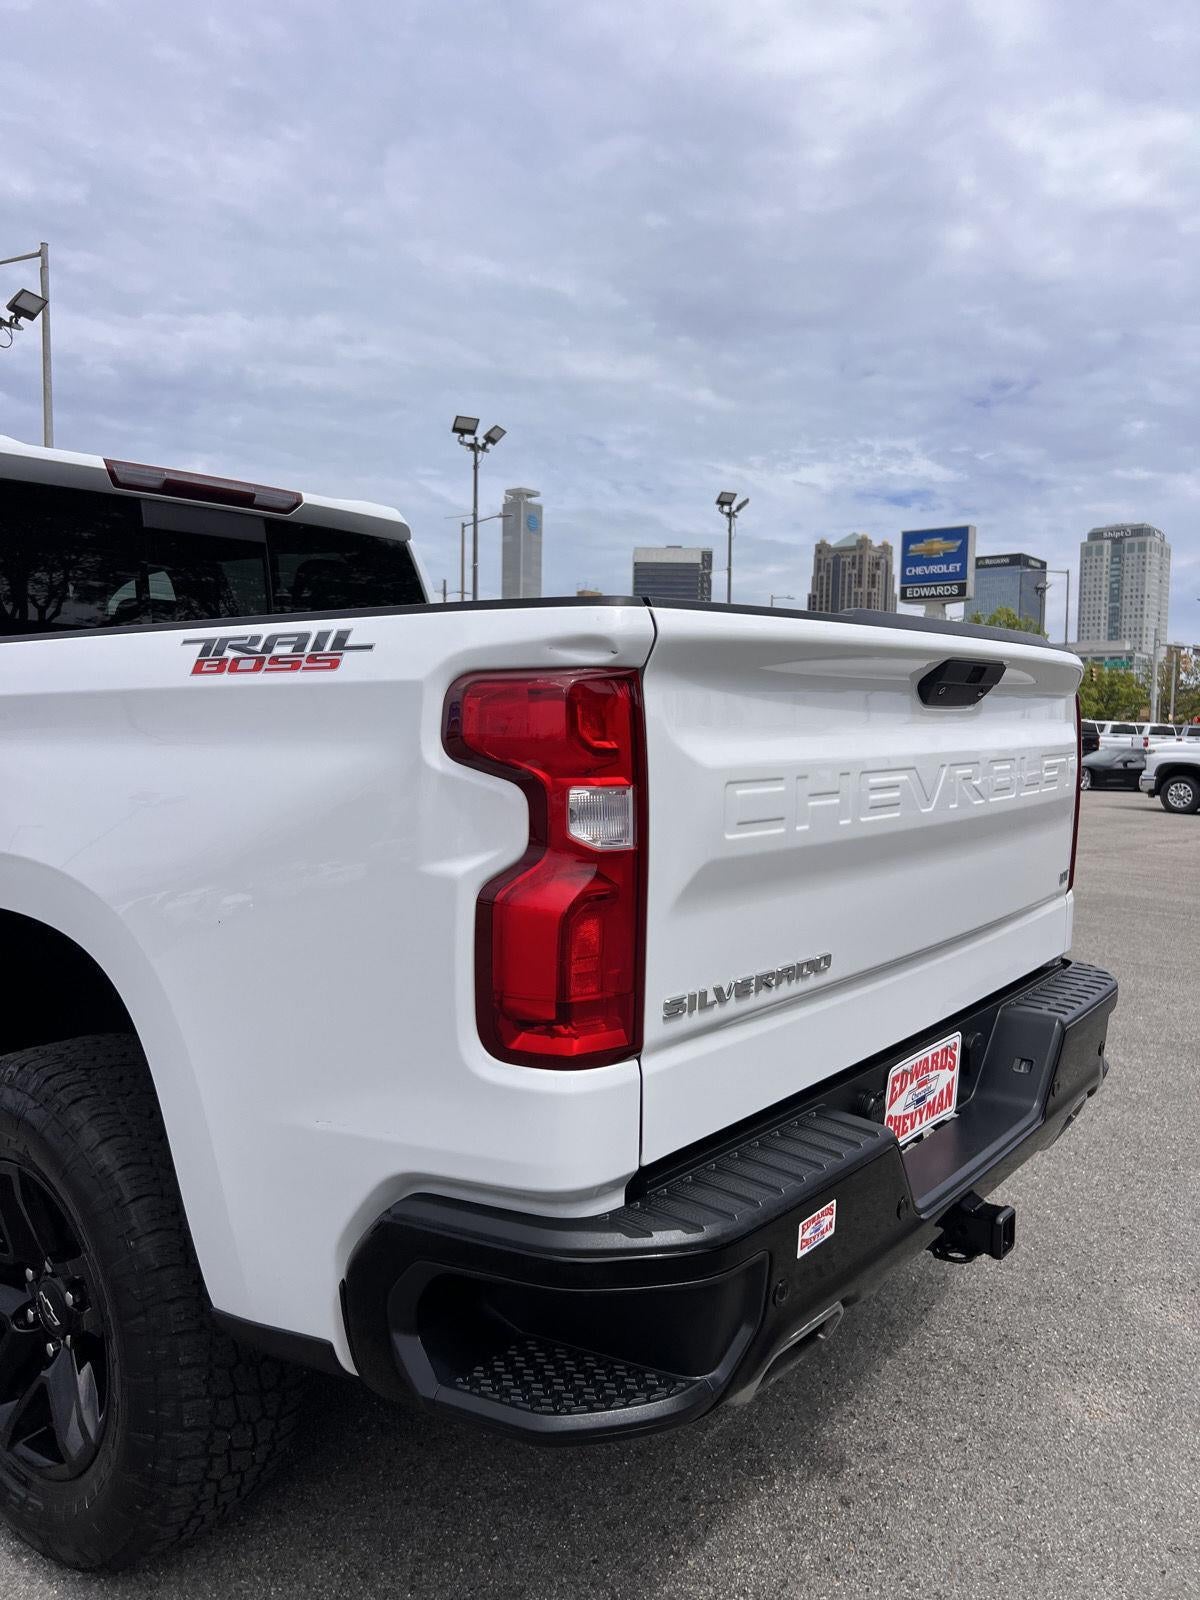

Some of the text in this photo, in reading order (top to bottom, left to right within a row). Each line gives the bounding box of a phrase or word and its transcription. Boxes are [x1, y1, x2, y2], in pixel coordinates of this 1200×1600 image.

[906, 563, 962, 576] CHEVROLET
[906, 585, 959, 597] EDWARDS
[181, 628, 376, 658] TRAIL
[190, 652, 343, 676] BOSS
[724, 752, 1076, 839] CHEVROLET
[663, 953, 832, 1019] SILVERADO
[888, 1042, 958, 1110] EDWARDS
[886, 1075, 956, 1140] CHEVYMAN
[801, 1217, 834, 1250] CHEVYMAN
[802, 1203, 834, 1236] EDWARDS
